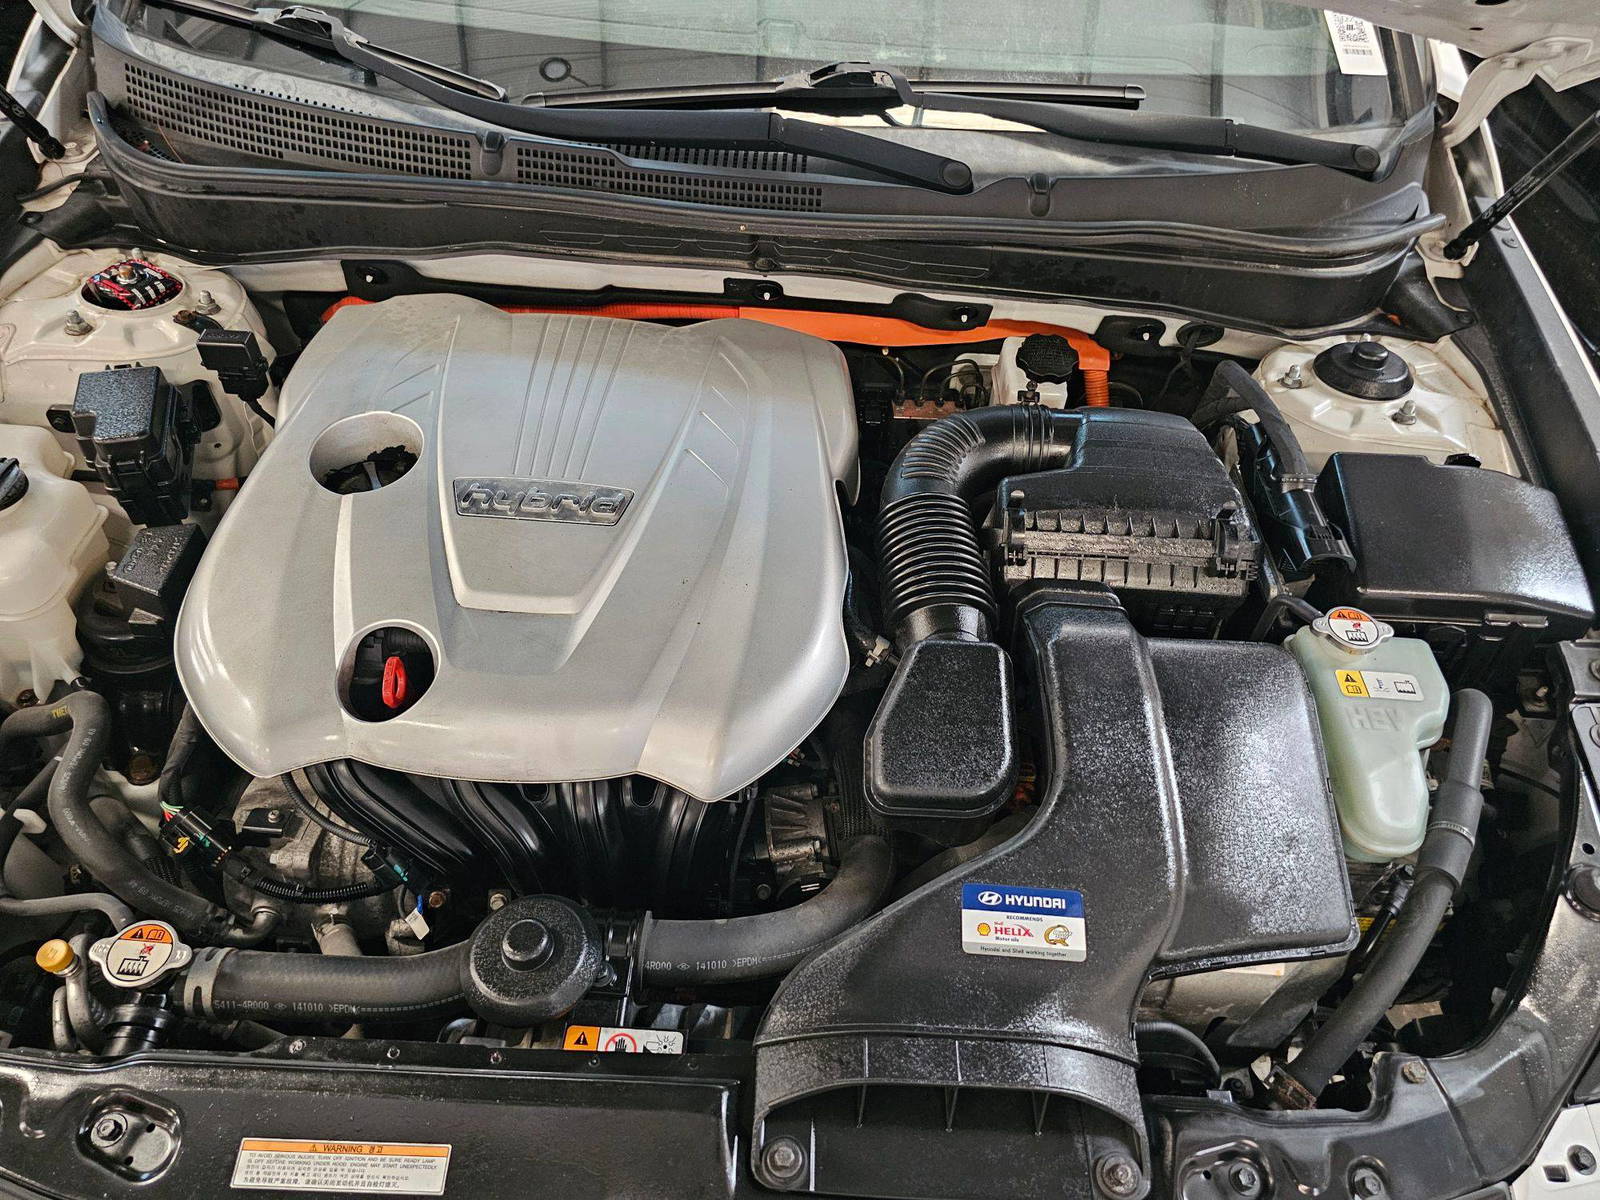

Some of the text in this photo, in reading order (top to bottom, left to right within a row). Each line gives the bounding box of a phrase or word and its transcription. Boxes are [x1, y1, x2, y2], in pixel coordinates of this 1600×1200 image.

[460, 483, 625, 515] hybrid
[1005, 893, 1066, 910] HYUNDAI
[994, 925, 1034, 938] HELIX
[696, 959, 727, 971] 141010
[292, 1002, 324, 1012] 141010
[323, 1144, 363, 1154] WARNING
